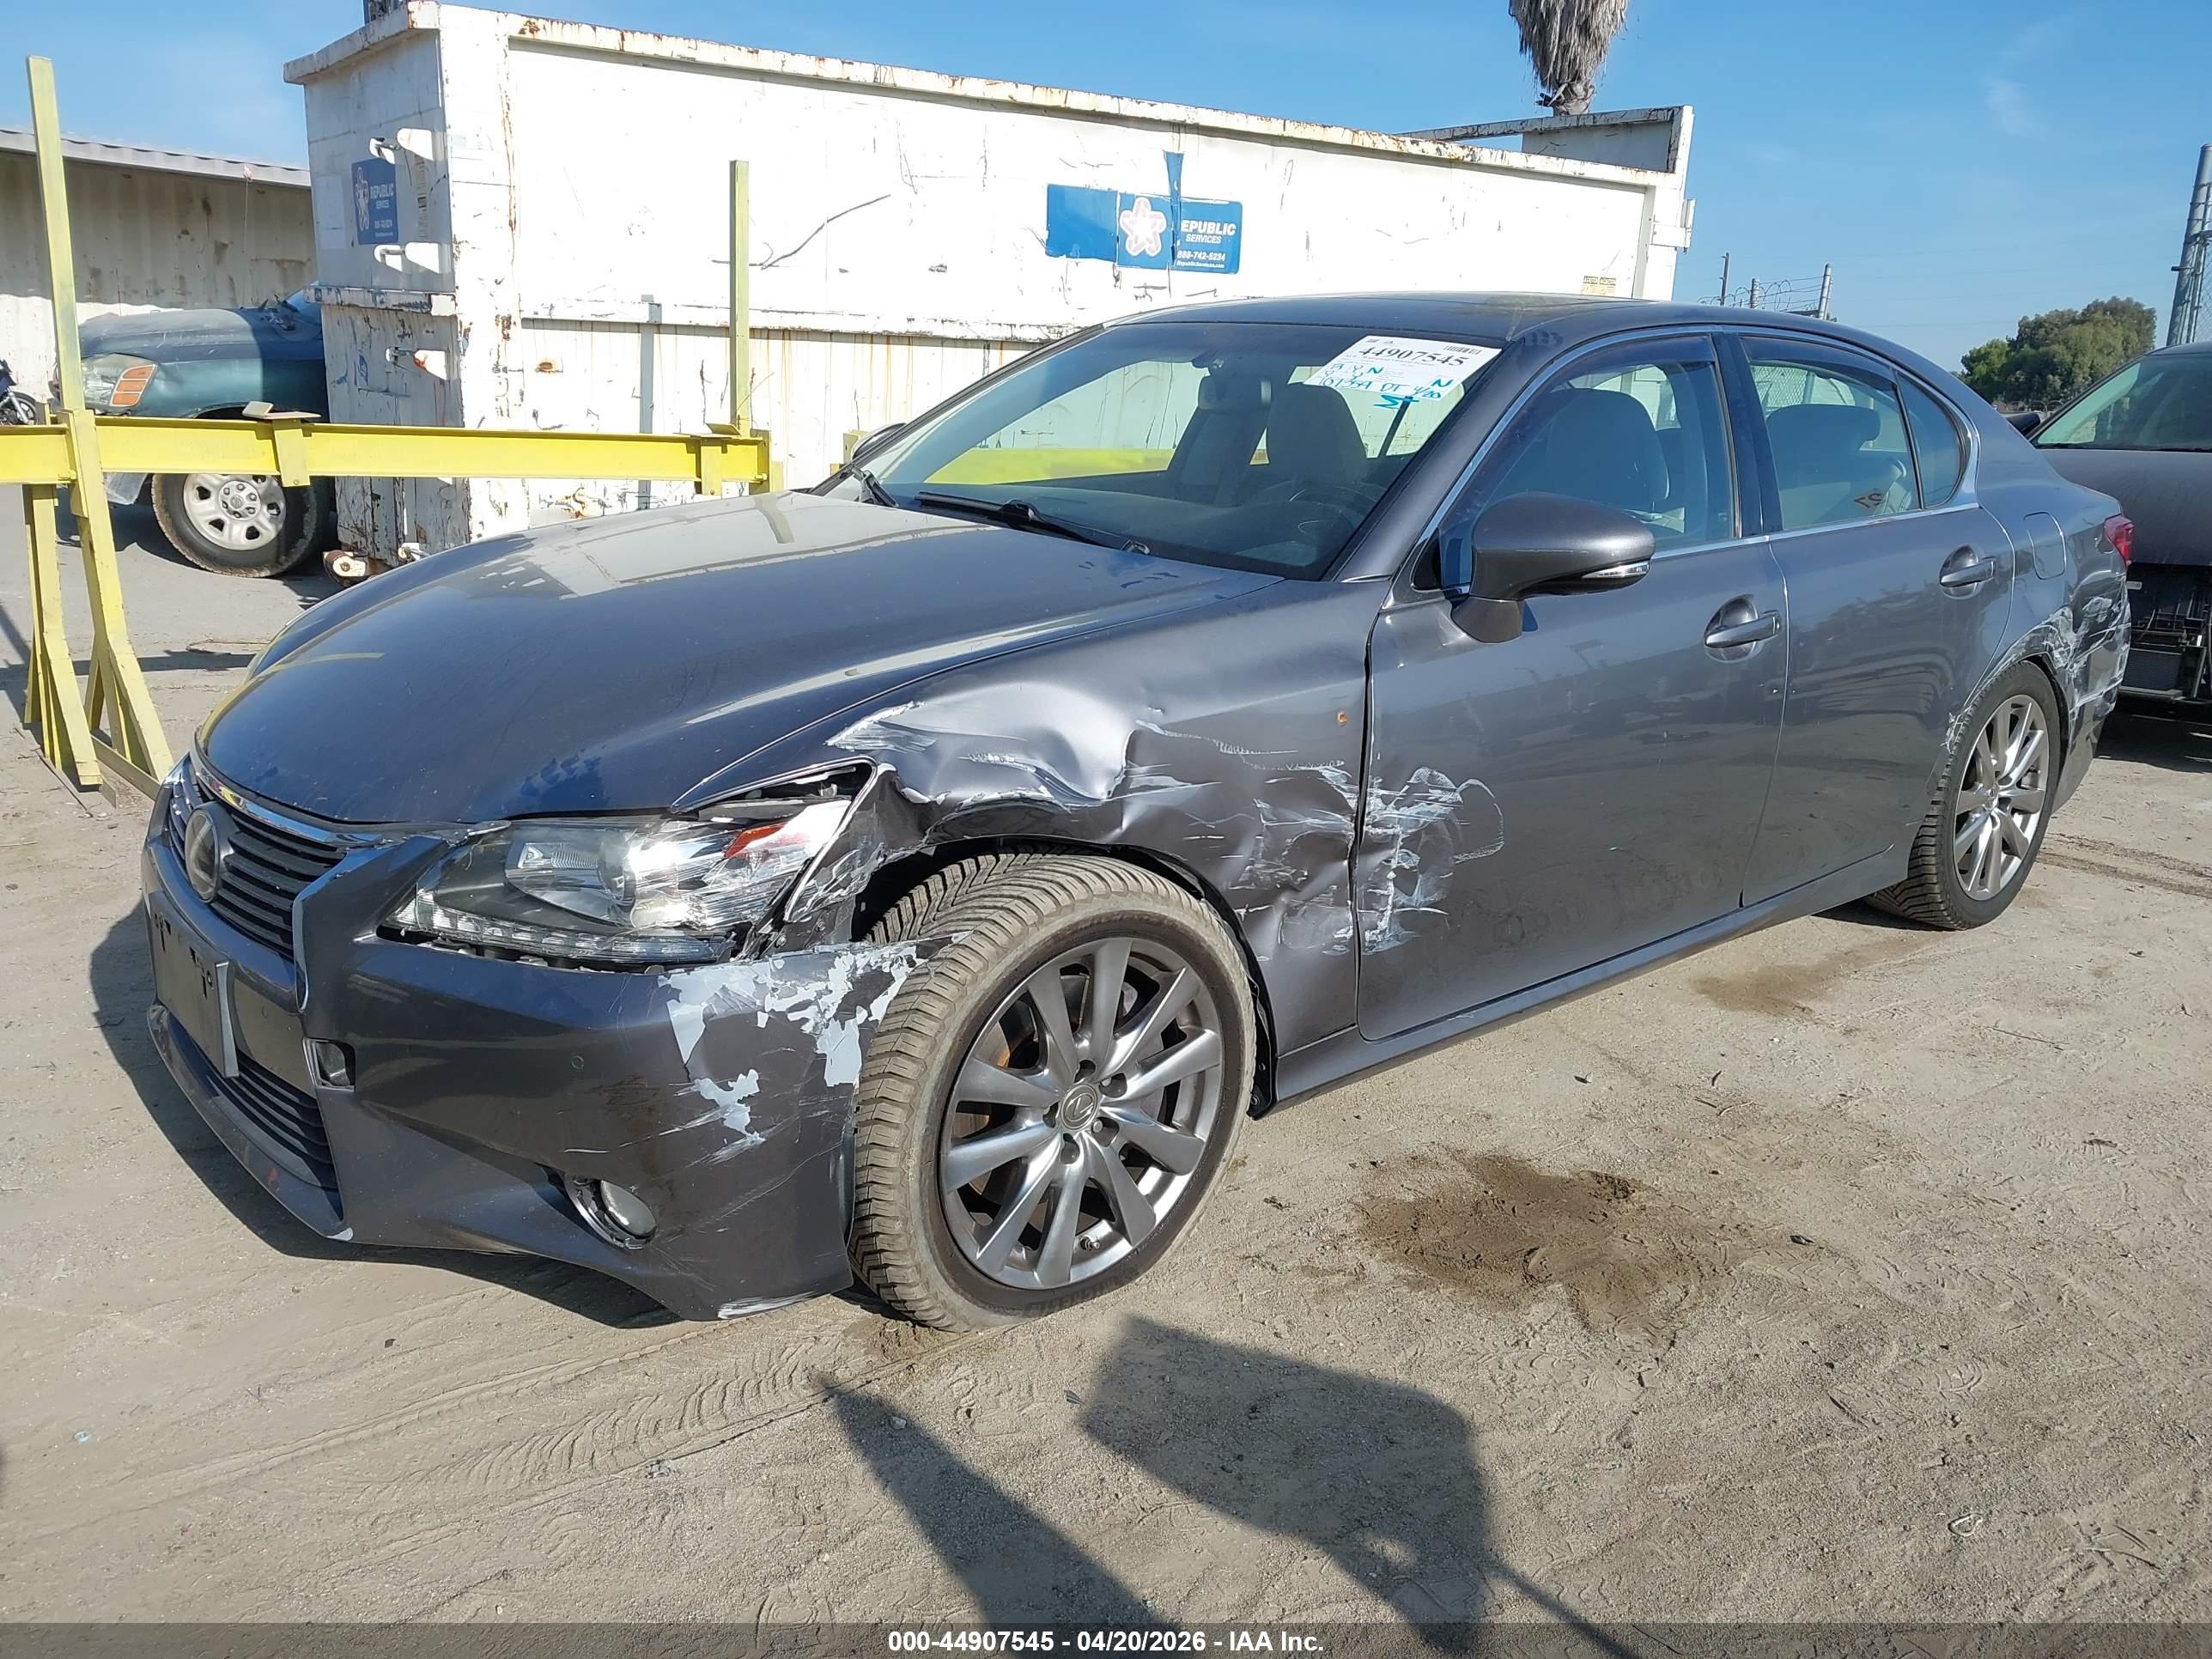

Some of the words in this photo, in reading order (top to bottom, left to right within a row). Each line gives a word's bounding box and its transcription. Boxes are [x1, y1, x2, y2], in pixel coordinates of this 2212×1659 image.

[1181, 220, 1237, 236] EPUBLIC
[1186, 234, 1222, 244] SERVICES
[1358, 347, 1469, 367] 44907545
